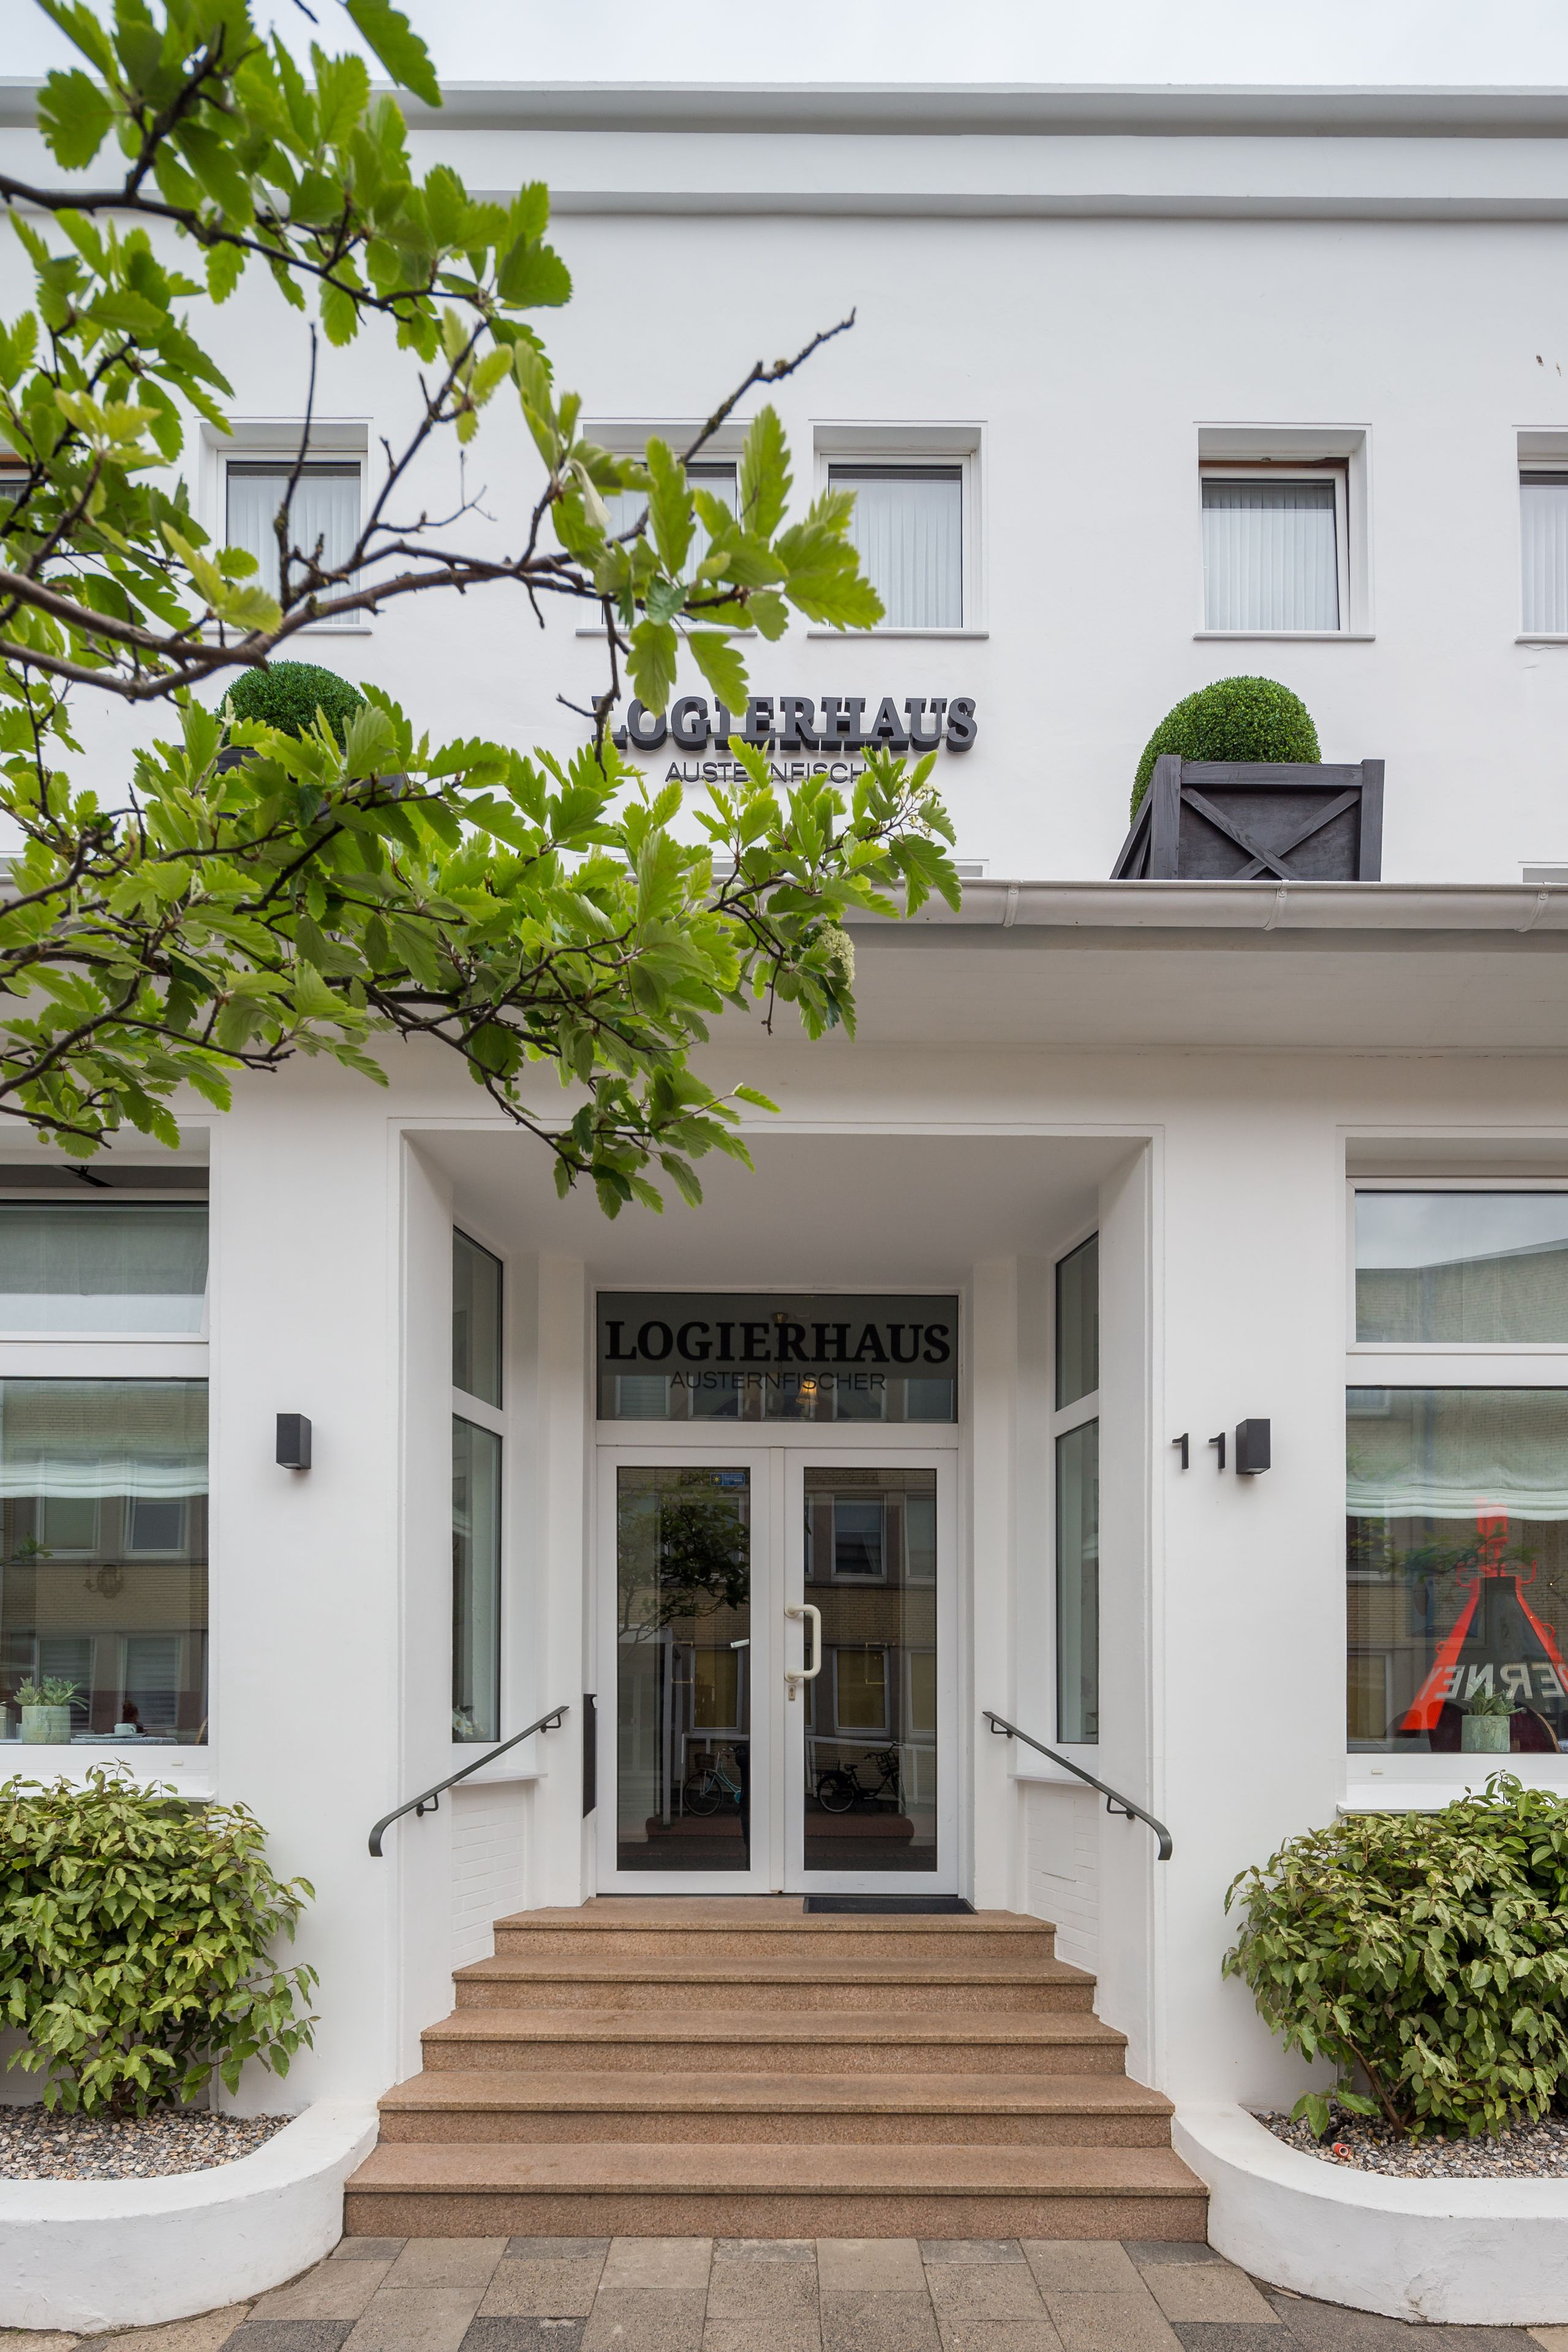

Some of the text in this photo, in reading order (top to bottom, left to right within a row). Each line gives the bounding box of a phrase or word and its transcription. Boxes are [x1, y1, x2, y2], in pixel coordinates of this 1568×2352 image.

[591, 696, 978, 752] LOGIERHAUS
[665, 761, 903, 783] AUSTENFISCH
[605, 1320, 951, 1363] LOGIERHAUS
[669, 1371, 886, 1390] AUSTERNFISCHER
[1172, 1431, 1225, 1469] 11
